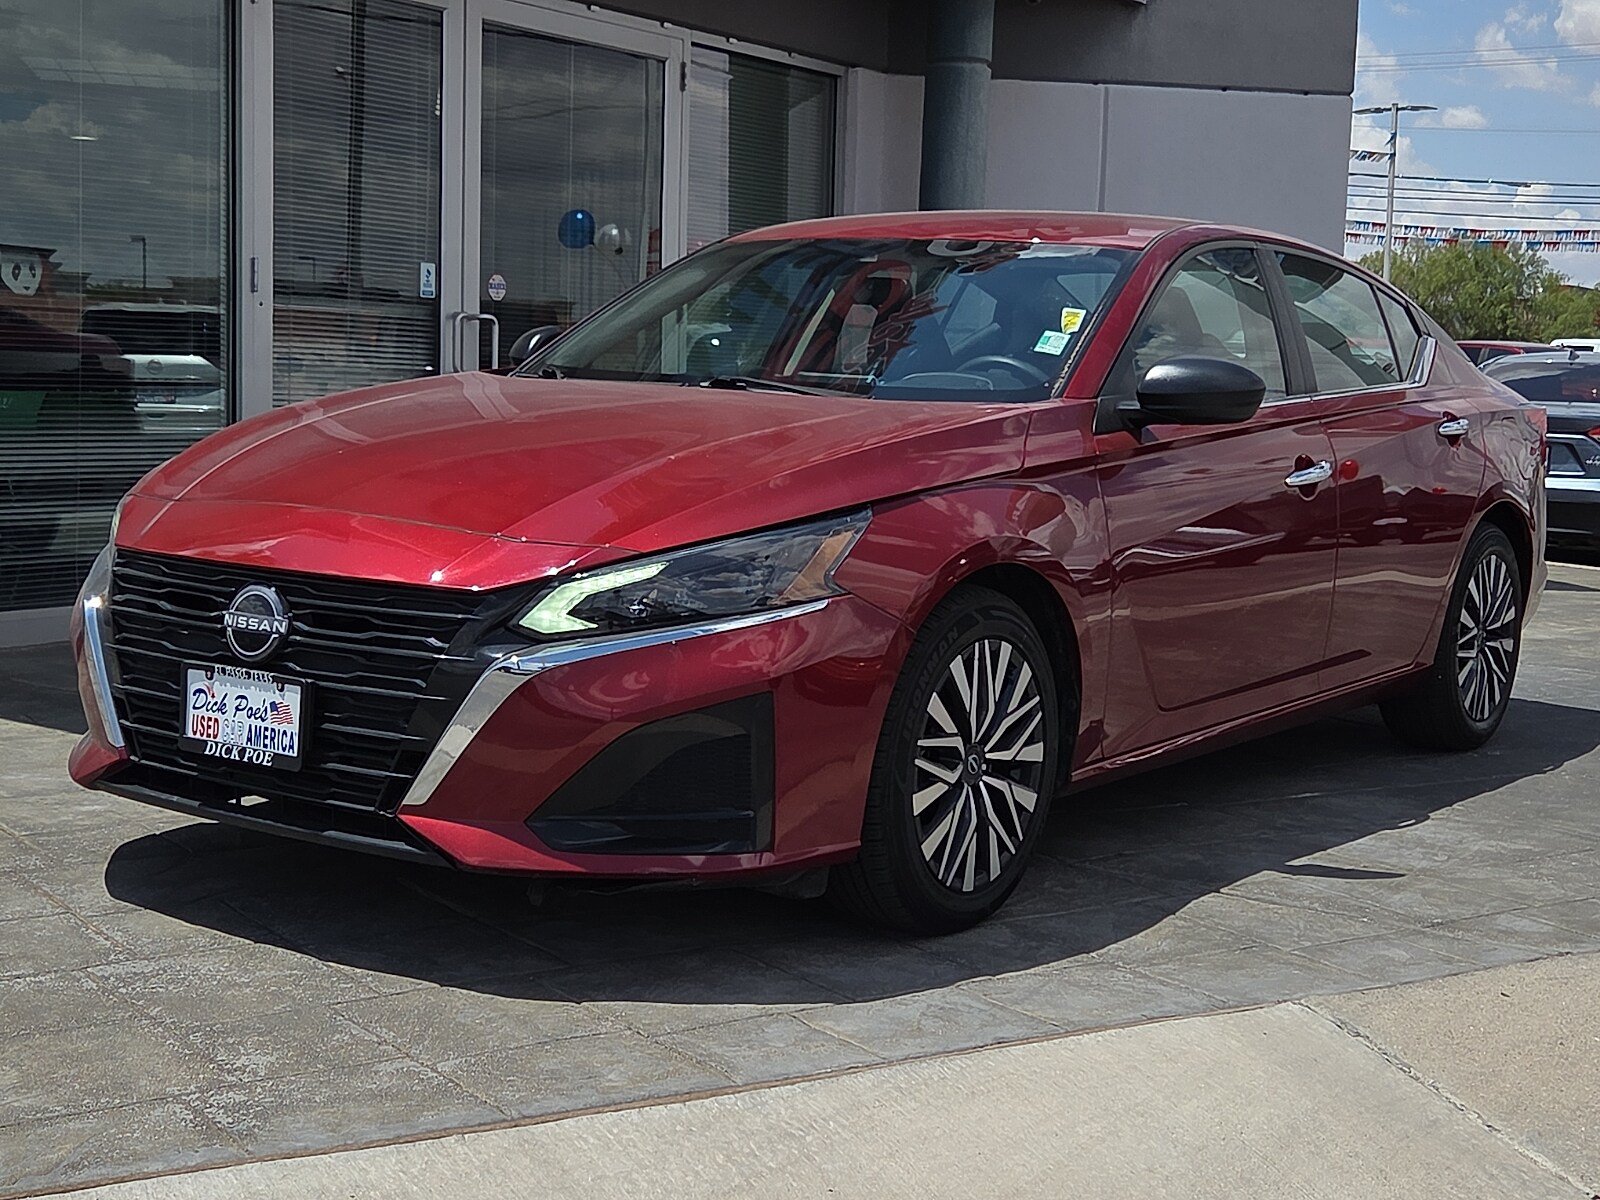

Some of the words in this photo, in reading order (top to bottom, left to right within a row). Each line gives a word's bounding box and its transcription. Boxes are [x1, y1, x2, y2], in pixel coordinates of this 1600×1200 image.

[224, 614, 286, 633] NISSAN
[192, 688, 228, 715] Dick
[233, 694, 268, 722] Poe's
[192, 714, 219, 739] USED
[246, 724, 295, 754] AMERICA
[204, 741, 241, 761] DICK
[243, 747, 274, 766] POE
